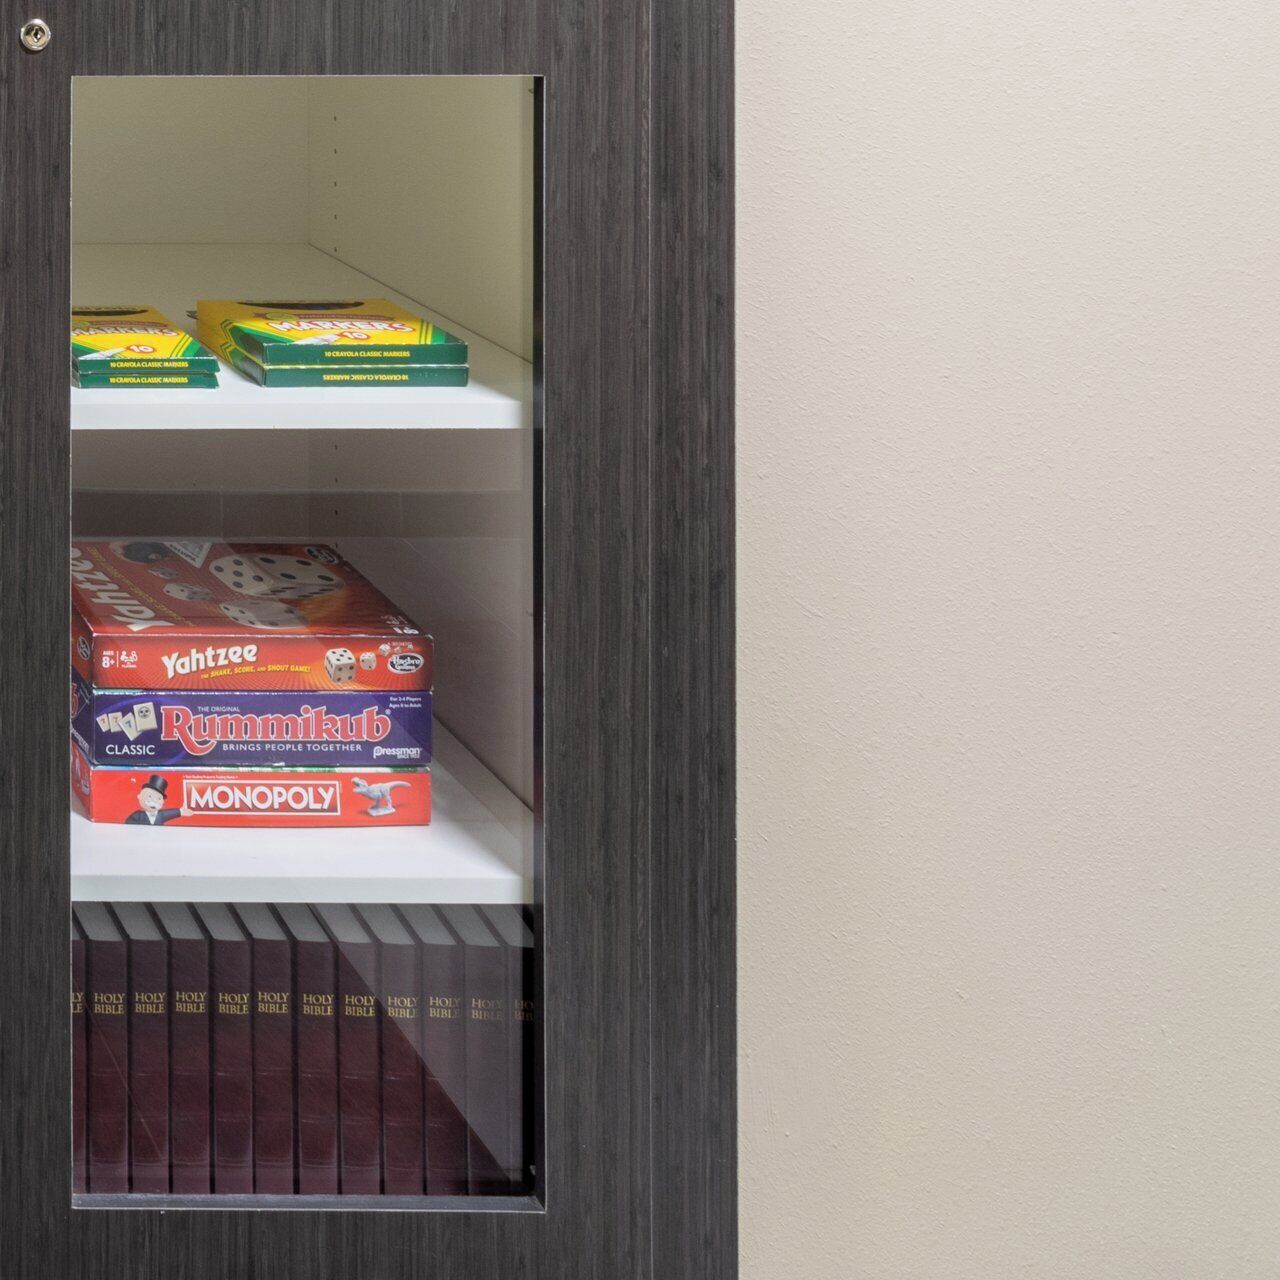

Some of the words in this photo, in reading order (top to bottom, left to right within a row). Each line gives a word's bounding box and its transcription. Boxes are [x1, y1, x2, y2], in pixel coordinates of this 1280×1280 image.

[268, 320, 414, 332] MARKERS
[102, 656, 115, 668] 8+
[161, 643, 258, 678] Yahtzee
[210, 667, 232, 678] SHAKE,
[233, 666, 256, 676] SCORE,
[268, 664, 290, 674] SHOUT
[291, 664, 311, 673] GAME!
[161, 704, 391, 757] Rummikub
[106, 744, 155, 756] CLASSIC
[222, 743, 263, 752] BRINGS
[264, 743, 300, 752] PEOPLE
[301, 743, 362, 752] TOGETHER
[372, 746, 420, 759] pressman
[190, 789, 334, 811] MONOPOLY
[94, 993, 125, 1004] HOLY
[135, 992, 166, 1003] HOLY
[176, 991, 206, 1002] HOLY
[218, 993, 249, 1004] HOLY
[258, 991, 289, 1002] HOLY
[94, 1003, 124, 1014] BIBLE
[135, 1002, 165, 1014] BIBLE
[176, 1002, 206, 1013] BIBLE
[218, 1004, 249, 1014] BIBLE
[258, 1002, 288, 1014] BIBLE
